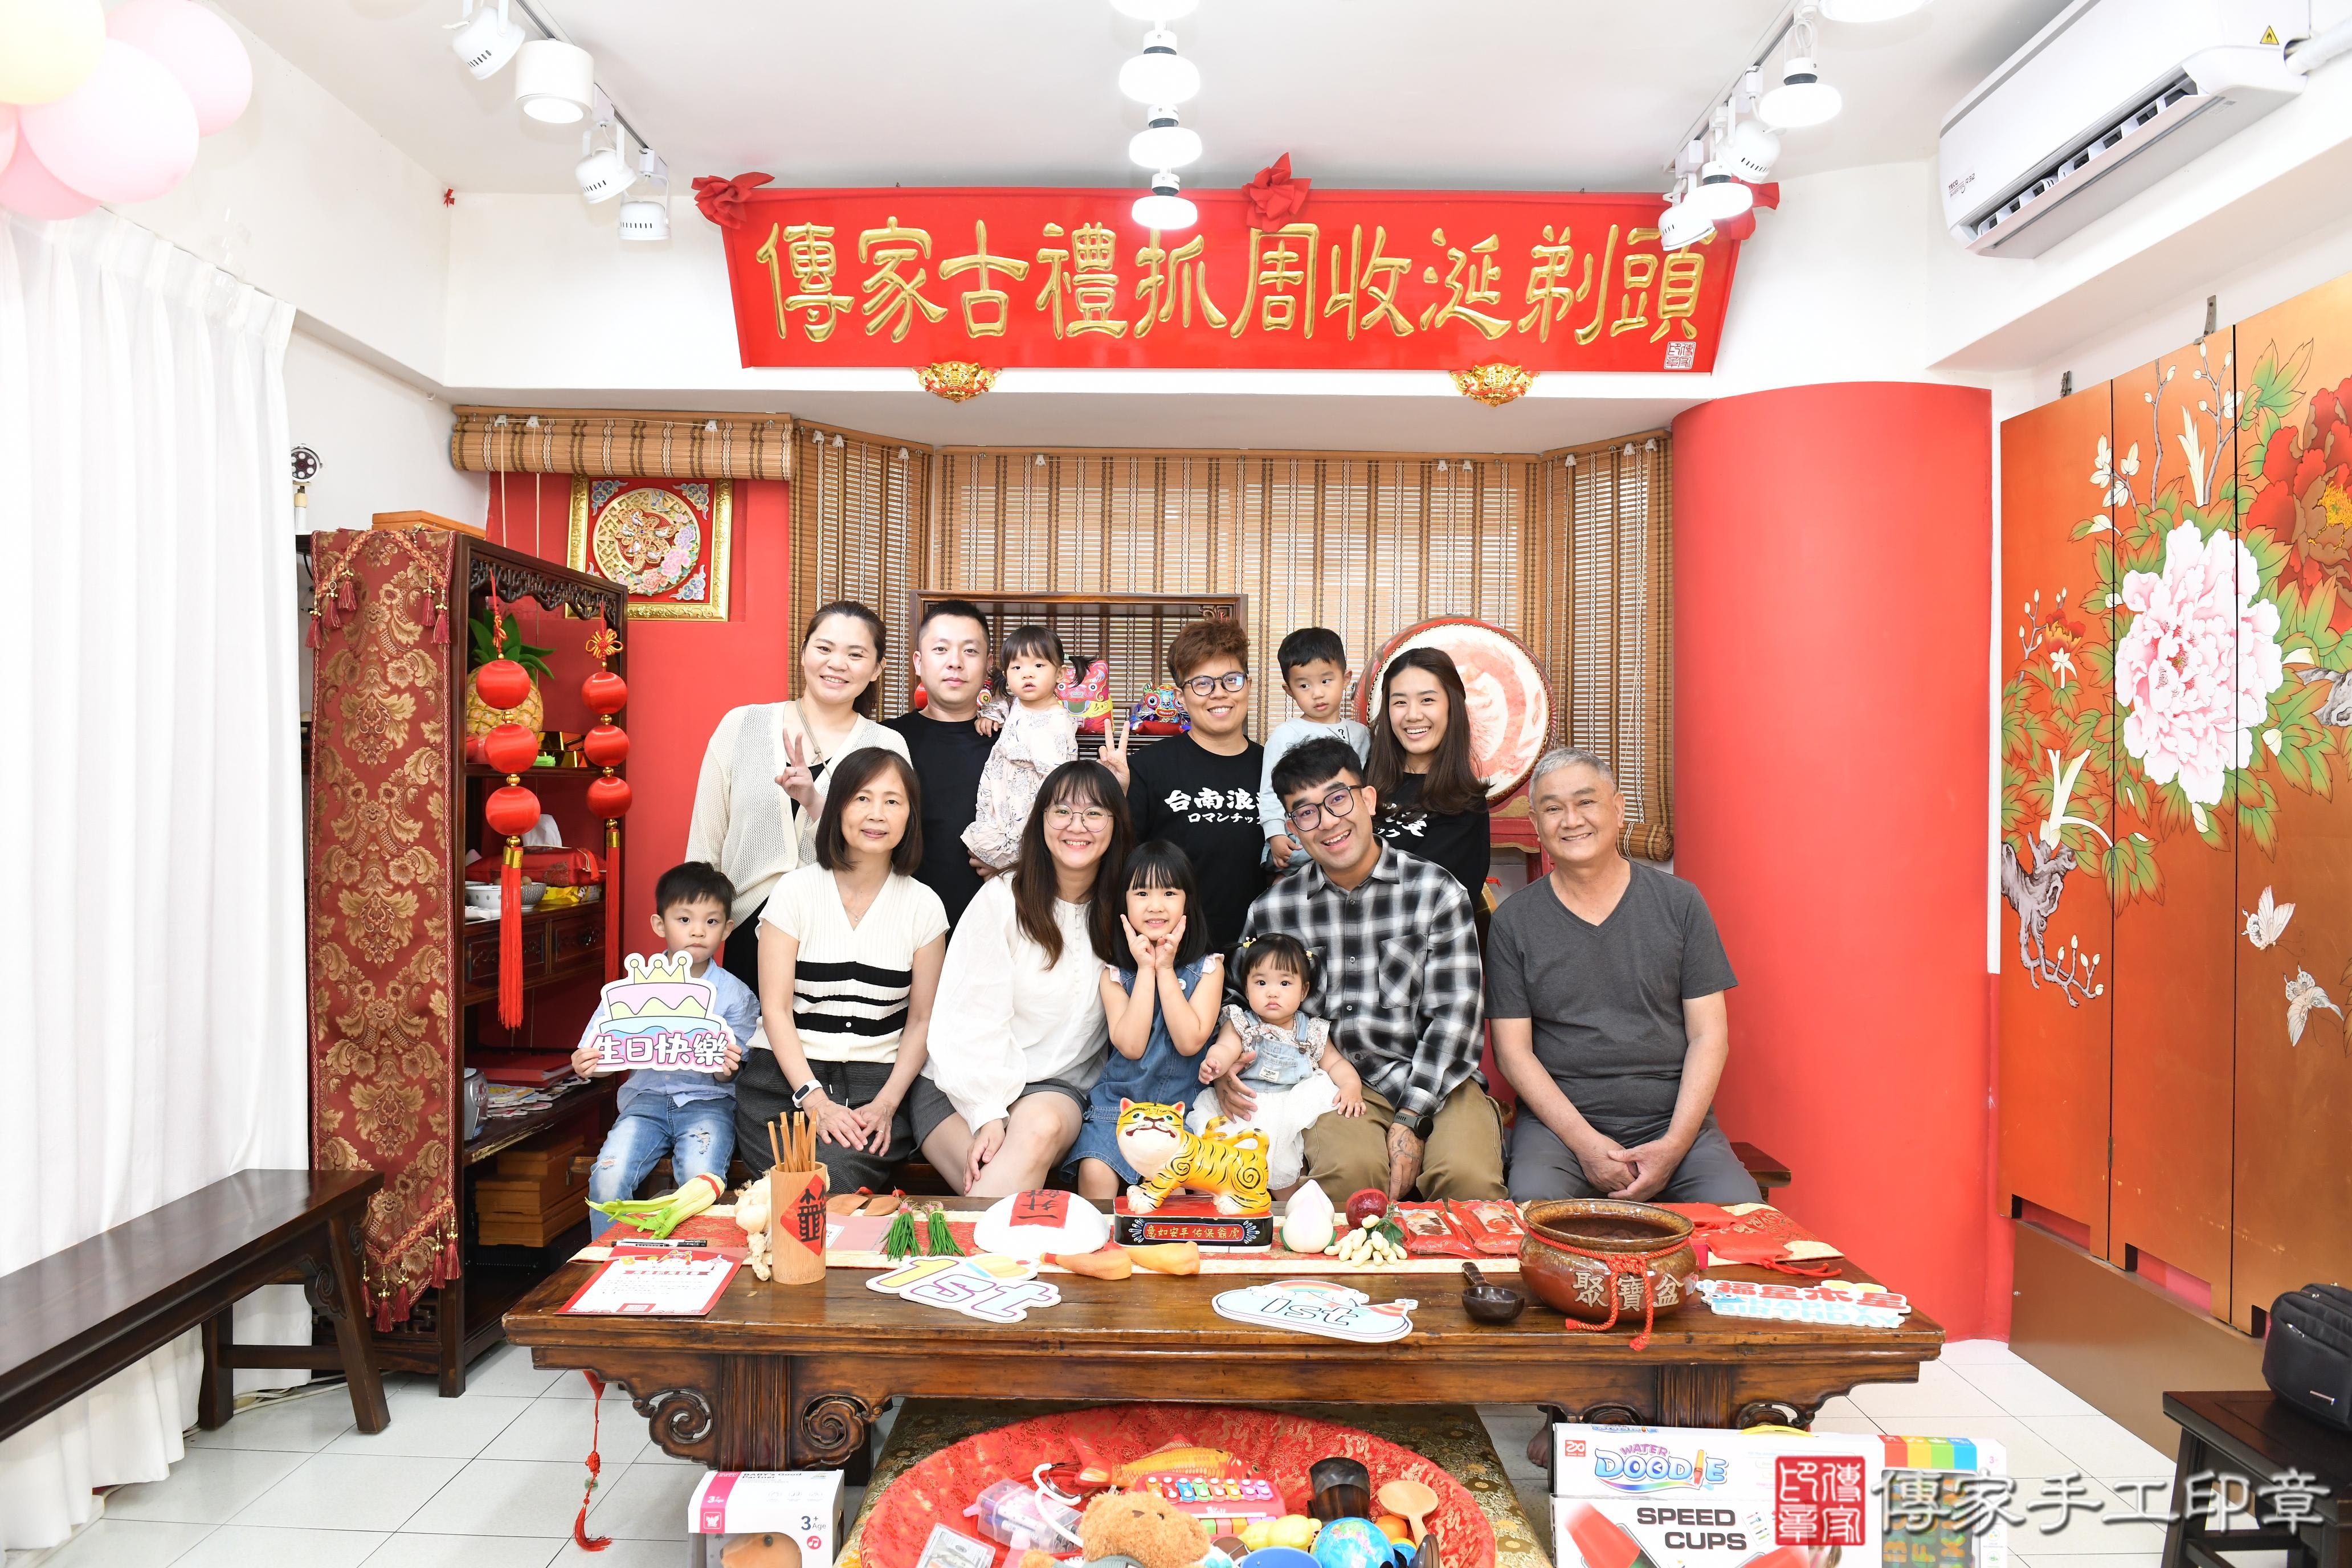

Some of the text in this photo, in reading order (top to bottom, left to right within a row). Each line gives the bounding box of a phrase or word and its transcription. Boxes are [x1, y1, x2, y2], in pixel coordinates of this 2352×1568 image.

[1949, 179, 1958, 191] TECO
[756, 215, 1718, 345] 傳家古禮抓周收涎剃頭
[1164, 787, 1261, 812] 台南浪
[593, 1031, 729, 1066] 生日快樂
[1146, 1224, 1240, 1240] 虎爺保佑平安如意
[1572, 1271, 1684, 1312] 聚寶盆
[1714, 1301, 1900, 1325] BIRTHDAY
[1749, 1297, 1873, 1314] HAPPY
[1619, 1443, 1669, 1456] WATER
[1637, 1507, 1736, 1526] SPEED
[812, 1522, 826, 1532] Age
[1664, 1532, 1747, 1550] CUPS
